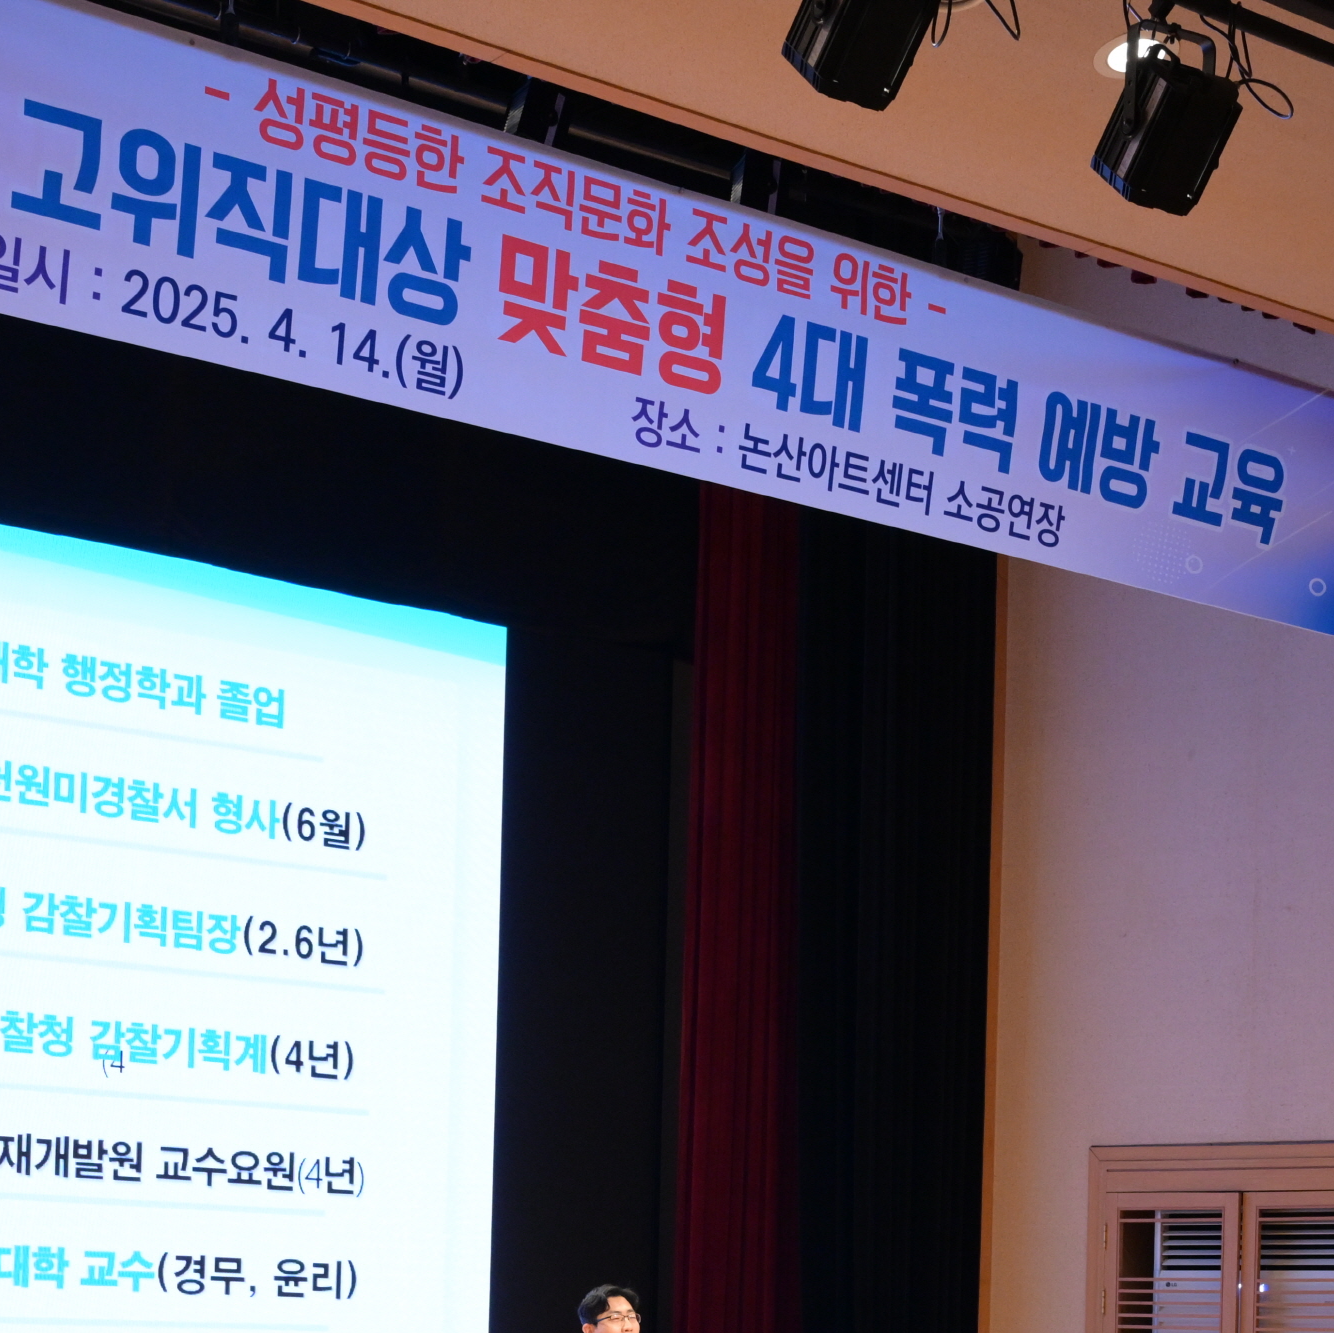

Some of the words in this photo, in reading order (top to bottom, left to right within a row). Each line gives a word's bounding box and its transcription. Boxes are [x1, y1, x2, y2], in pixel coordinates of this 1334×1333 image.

[254, 78, 465, 194] 성평등한
[481, 146, 671, 256] 조직문화
[686, 208, 814, 300] 조성을
[830, 252, 912, 325] 위한
[11, 98, 471, 326] 고위직대상
[498, 233, 727, 395] 맞춤형
[752, 314, 868, 433] 4대
[891, 347, 1019, 475] 폭력
[1038, 391, 1161, 510] 예방
[1171, 432, 1285, 546] 교육
[121, 269, 249, 344] 2025.
[268, 308, 307, 358] 4.
[330, 322, 464, 400] 14.(월)
[631, 395, 701, 454] 장소
[738, 422, 935, 517] 논산아트센터
[943, 480, 1066, 548] 소공연장
[60, 653, 207, 716] 행정학과
[217, 680, 286, 729] 졸업
[212, 791, 366, 851] 형사(6월)
[155, 1145, 365, 1198] 교수요원(4년)
[273, 1257, 358, 1300] 윤리)
